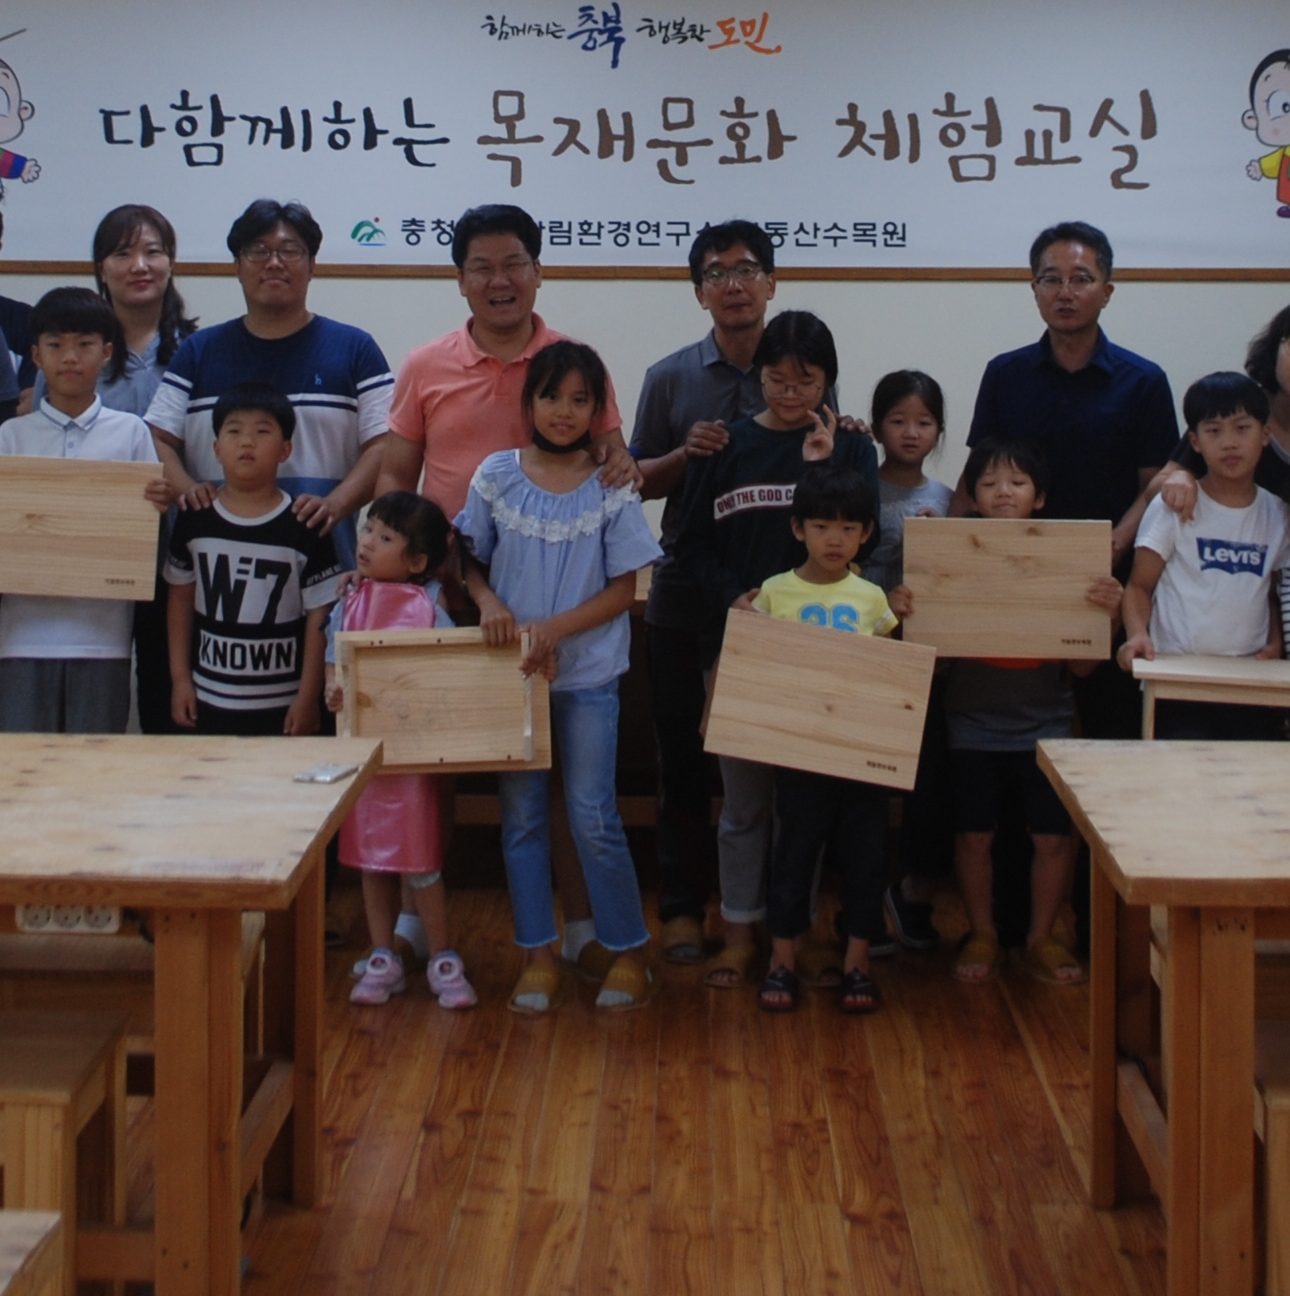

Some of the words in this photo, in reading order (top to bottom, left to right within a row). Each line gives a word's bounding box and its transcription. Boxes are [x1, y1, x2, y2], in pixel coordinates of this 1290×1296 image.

[480, 14, 566, 41] 함께하는
[567, 2, 626, 69] 충북
[636, 17, 711, 45] 행복한
[707, 11, 782, 54] 도민
[98, 89, 451, 168] 다함께하는
[476, 90, 798, 188] 목재문화
[835, 88, 1157, 190] 체험교실
[754, 220, 907, 249] 동산수목원
[736, 490, 756, 505] THE
[758, 488, 782, 502] GOD
[201, 634, 294, 671] KNOWN
